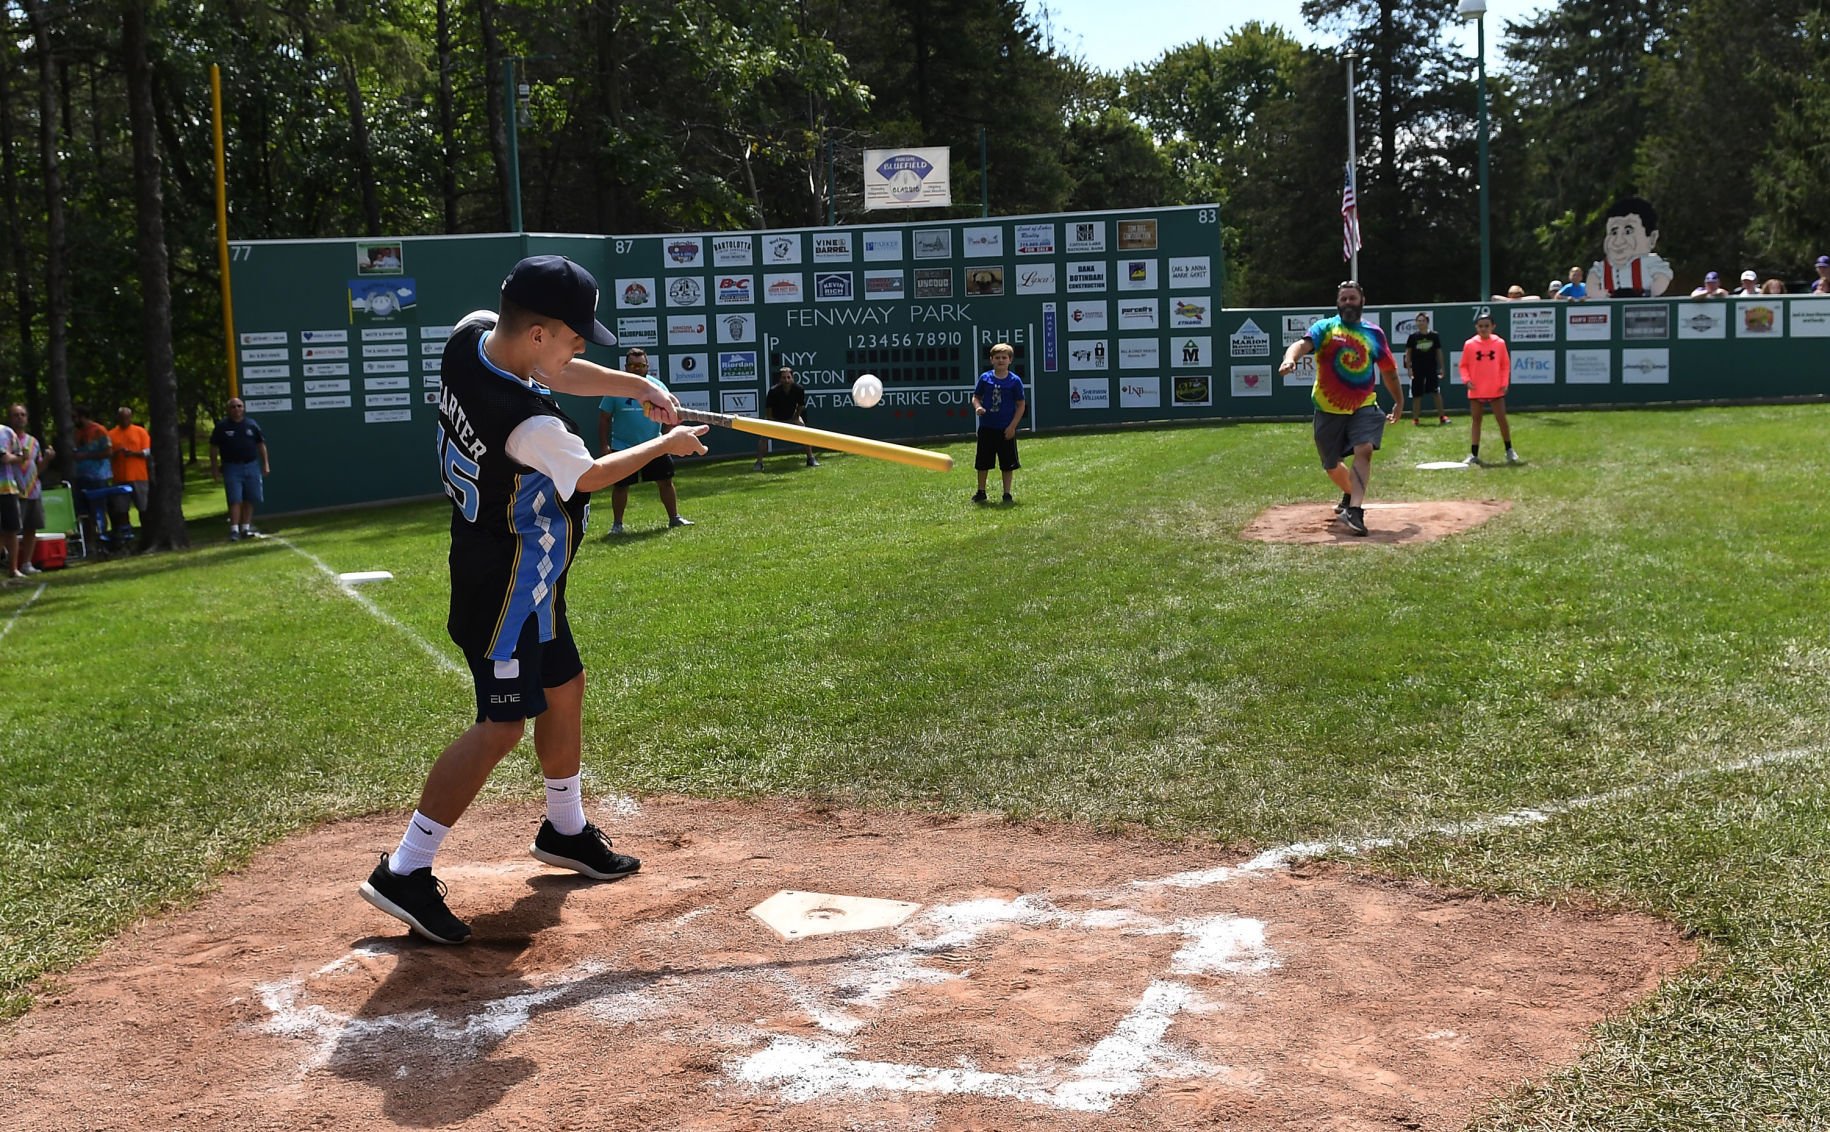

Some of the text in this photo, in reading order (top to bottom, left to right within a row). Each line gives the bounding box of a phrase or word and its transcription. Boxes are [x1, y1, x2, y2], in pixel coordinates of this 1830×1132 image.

[883, 162, 928, 170] BLUEFIELD
[1198, 209, 1217, 224] 83
[615, 240, 634, 254] 87
[815, 239, 838, 247] VINE
[815, 246, 850, 254] BARREL
[231, 246, 252, 261] 77
[787, 303, 972, 328] FENWAY PARK
[1471, 306, 1491, 321] 79
[770, 337, 780, 350] P
[982, 329, 1024, 344] R H E
[721, 361, 754, 369] Riordan
[781, 351, 817, 366] NYY
[794, 370, 844, 385] OSTON
[804, 391, 974, 408] AT BA STRIKE OUT
[490, 693, 520, 703] ELITE
